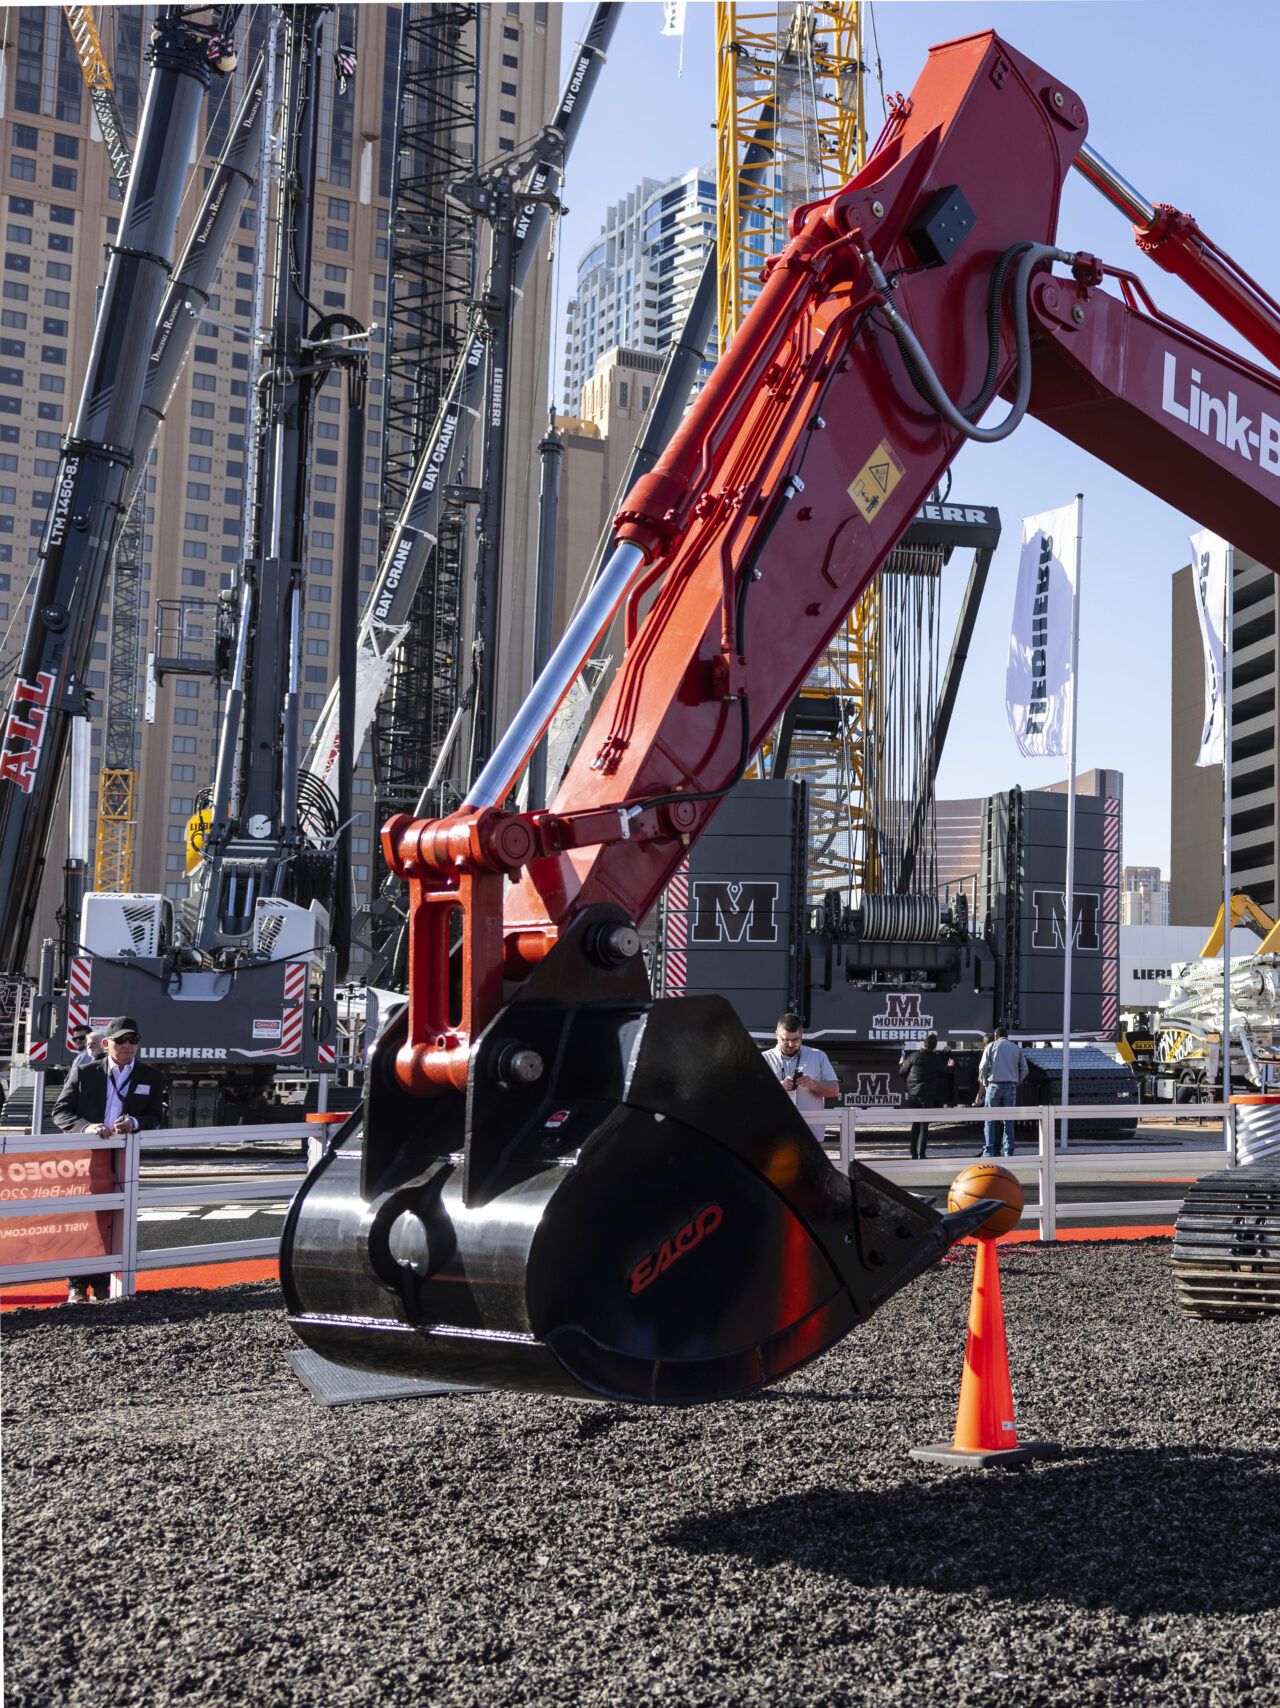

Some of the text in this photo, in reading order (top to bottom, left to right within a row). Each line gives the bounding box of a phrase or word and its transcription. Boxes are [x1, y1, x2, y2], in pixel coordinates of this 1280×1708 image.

[562, 57, 590, 114] BAY CRANE
[516, 173, 547, 239] BAY CNE
[468, 340, 485, 367] BAY
[492, 367, 504, 427] LIEBHERR
[421, 414, 458, 492] BAY CRANE
[50, 456, 80, 546] LTM 1450-8.1
[375, 539, 413, 618] BAY CRANE
[0, 671, 56, 794] ALL
[874, 1017, 932, 1027] MOUNTAIN
[140, 1047, 227, 1059] LIEBHERR
[846, 1096, 899, 1104] MOUNTAIN
